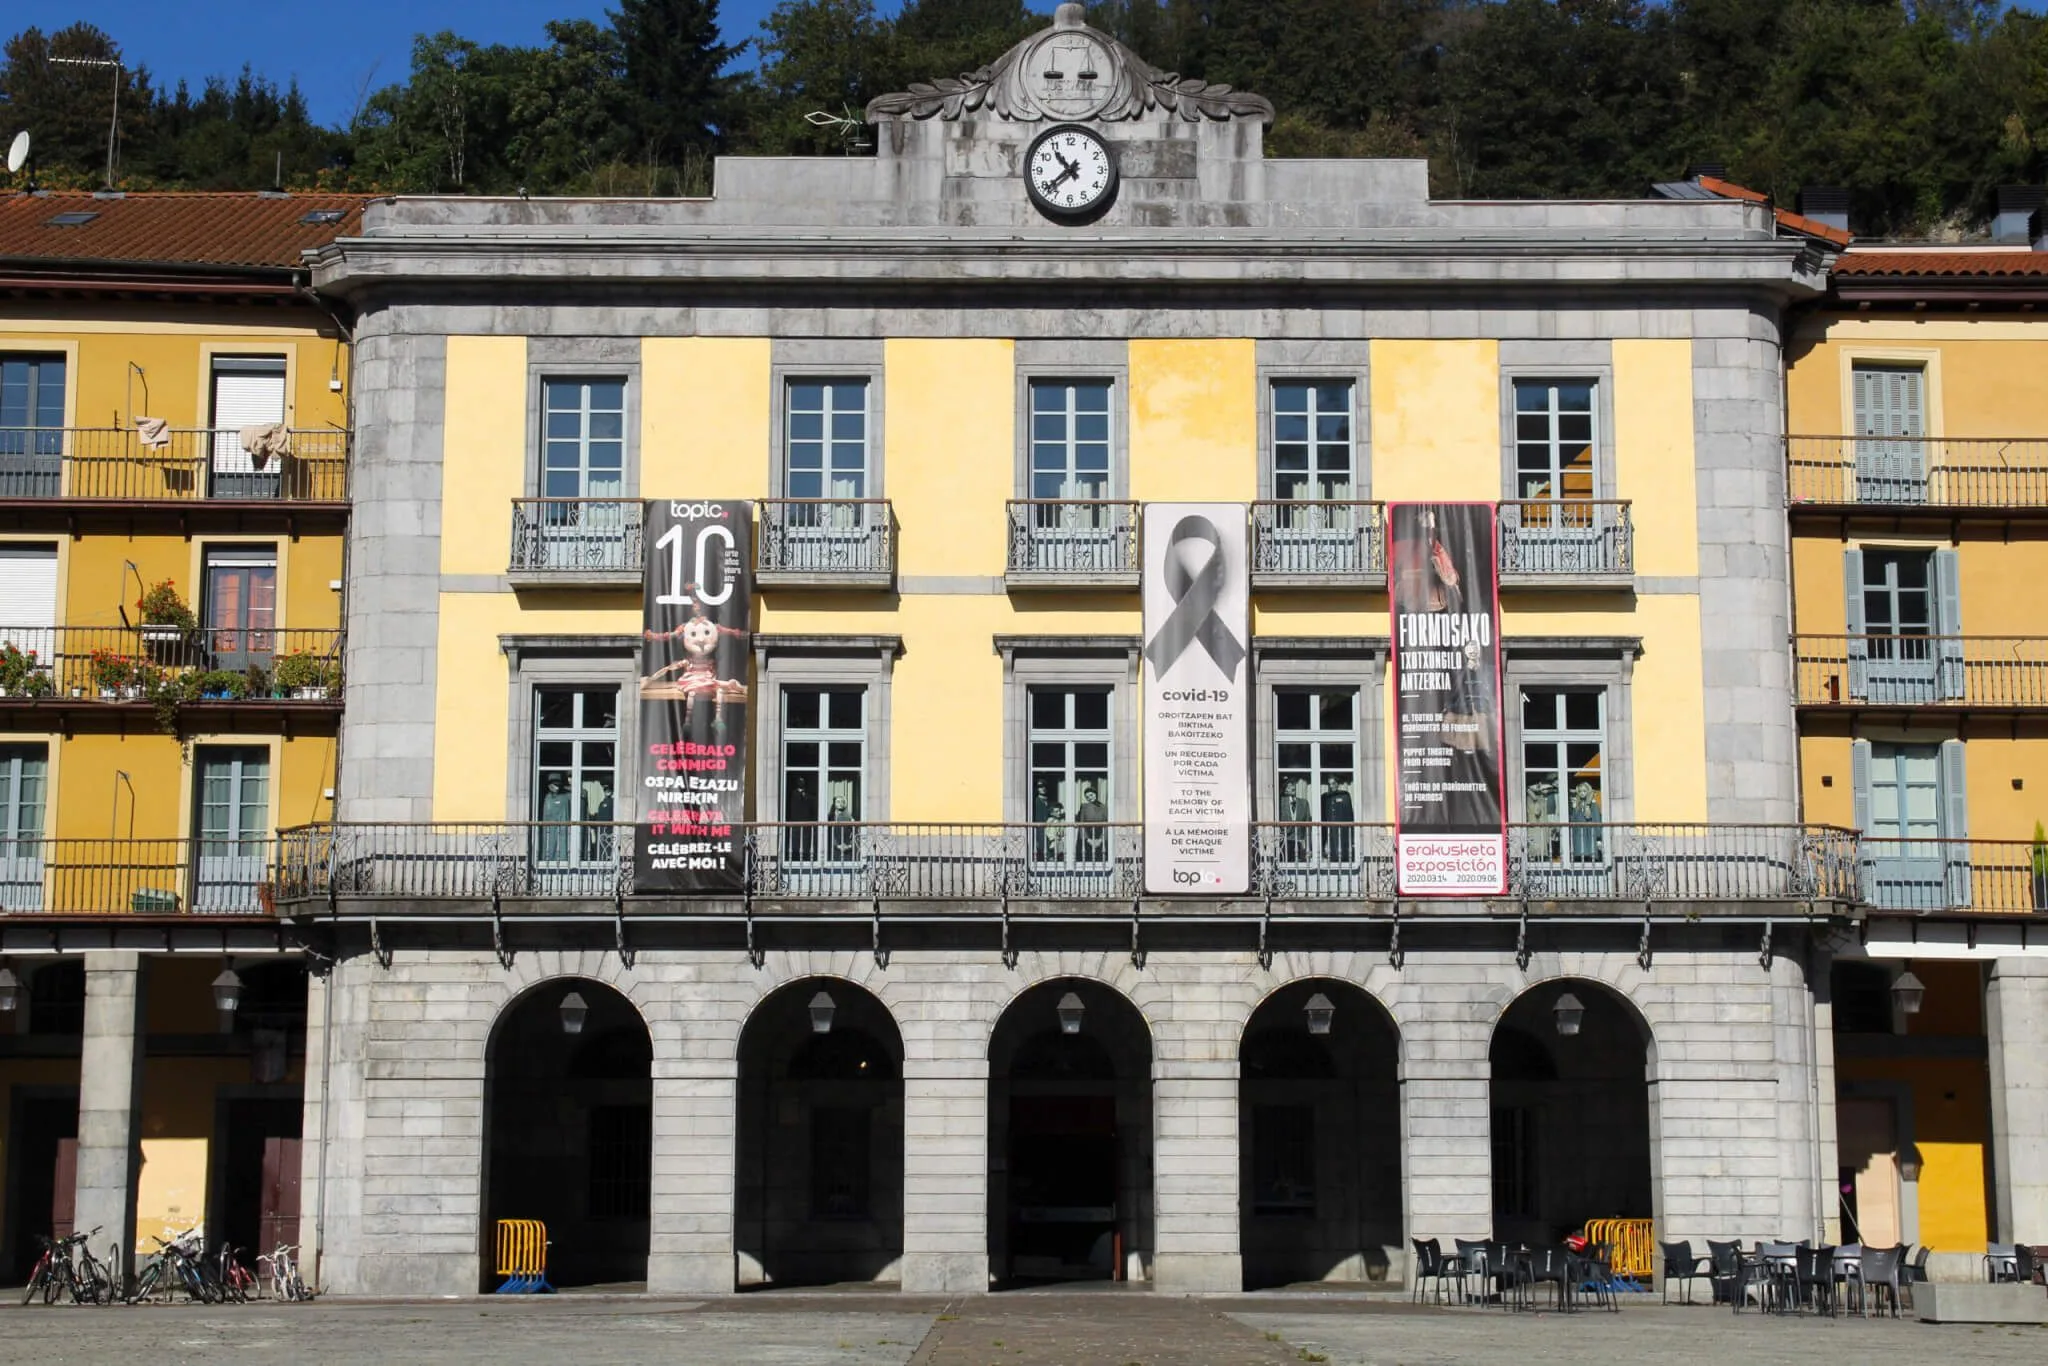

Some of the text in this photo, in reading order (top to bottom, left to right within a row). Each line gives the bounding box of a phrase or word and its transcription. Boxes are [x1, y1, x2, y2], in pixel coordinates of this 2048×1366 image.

[1051, 142, 1059, 150] 11
[1066, 137, 1075, 146] 12
[1083, 142, 1087, 150] 1
[1041, 153, 1051, 161] 10
[1093, 152, 1099, 160] 2
[1036, 166, 1043, 175] 9
[1097, 166, 1104, 174] 3
[1092, 181, 1099, 189] 4
[1053, 191, 1060, 199] 7
[1066, 194, 1074, 203] 6
[1080, 191, 1087, 199] 5
[655, 524, 735, 606] 10
[1400, 613, 1490, 647] FORMOSAKO
[1400, 651, 1462, 670] TXOTXONGILO
[1400, 672, 1451, 691] ANTZERKIA
[1162, 688, 1229, 702] covid-19
[1158, 712, 1214, 720] OROITZAPEN
[1168, 731, 1223, 739] BAKOITZEKO
[649, 741, 736, 757] CELÉBRALO
[656, 759, 727, 771] CONMIGO
[645, 776, 738, 791] OSPA EZAZU
[657, 791, 718, 805] NIREKIN
[647, 810, 723, 822] CELEBRATE
[651, 824, 732, 837] IT WITH ME
[1406, 844, 1496, 857] erakusketa
[651, 857, 687, 869] AVEC
[1406, 858, 1497, 874] exposición
